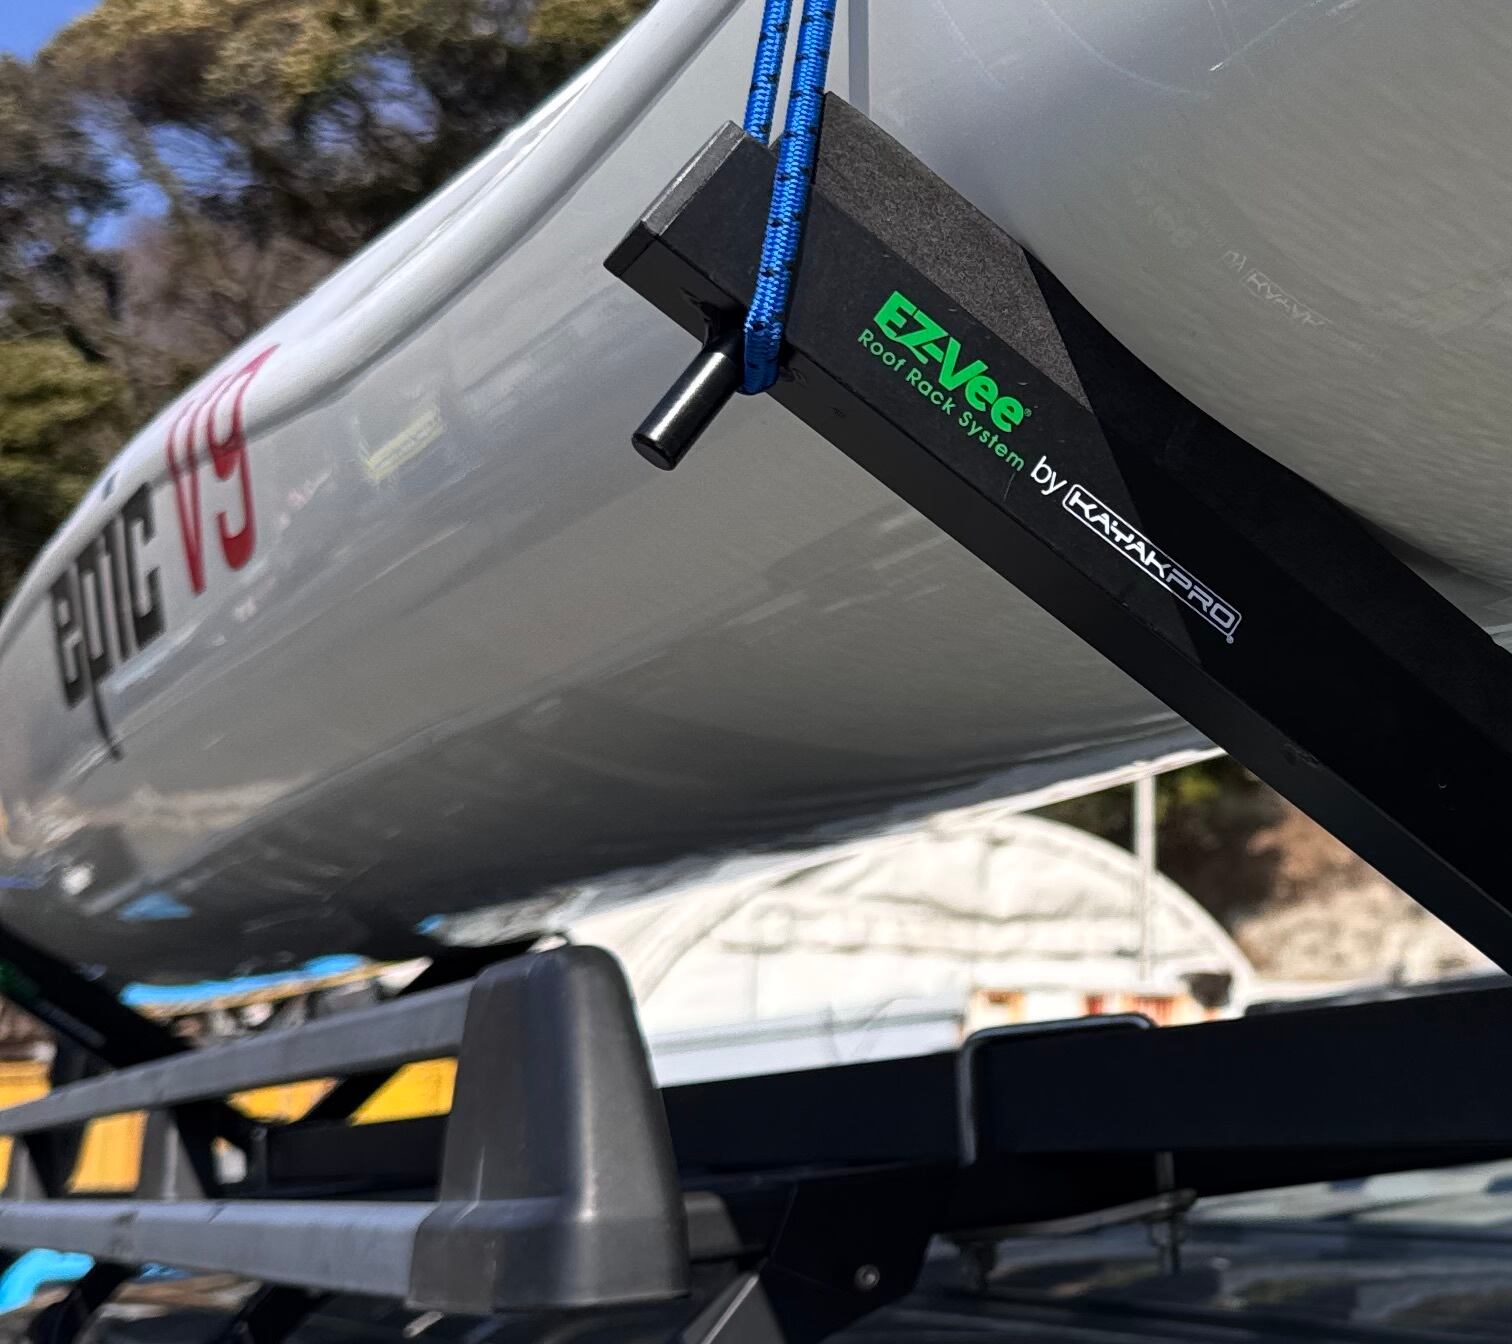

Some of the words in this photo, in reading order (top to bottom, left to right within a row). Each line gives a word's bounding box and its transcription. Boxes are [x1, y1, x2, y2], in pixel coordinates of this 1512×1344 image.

[857, 328, 907, 372] Roof
[905, 367, 957, 416] Rack
[958, 410, 1025, 472] System
[1030, 455, 1068, 496] by
[1068, 490, 1236, 630] KAYAKPRO
